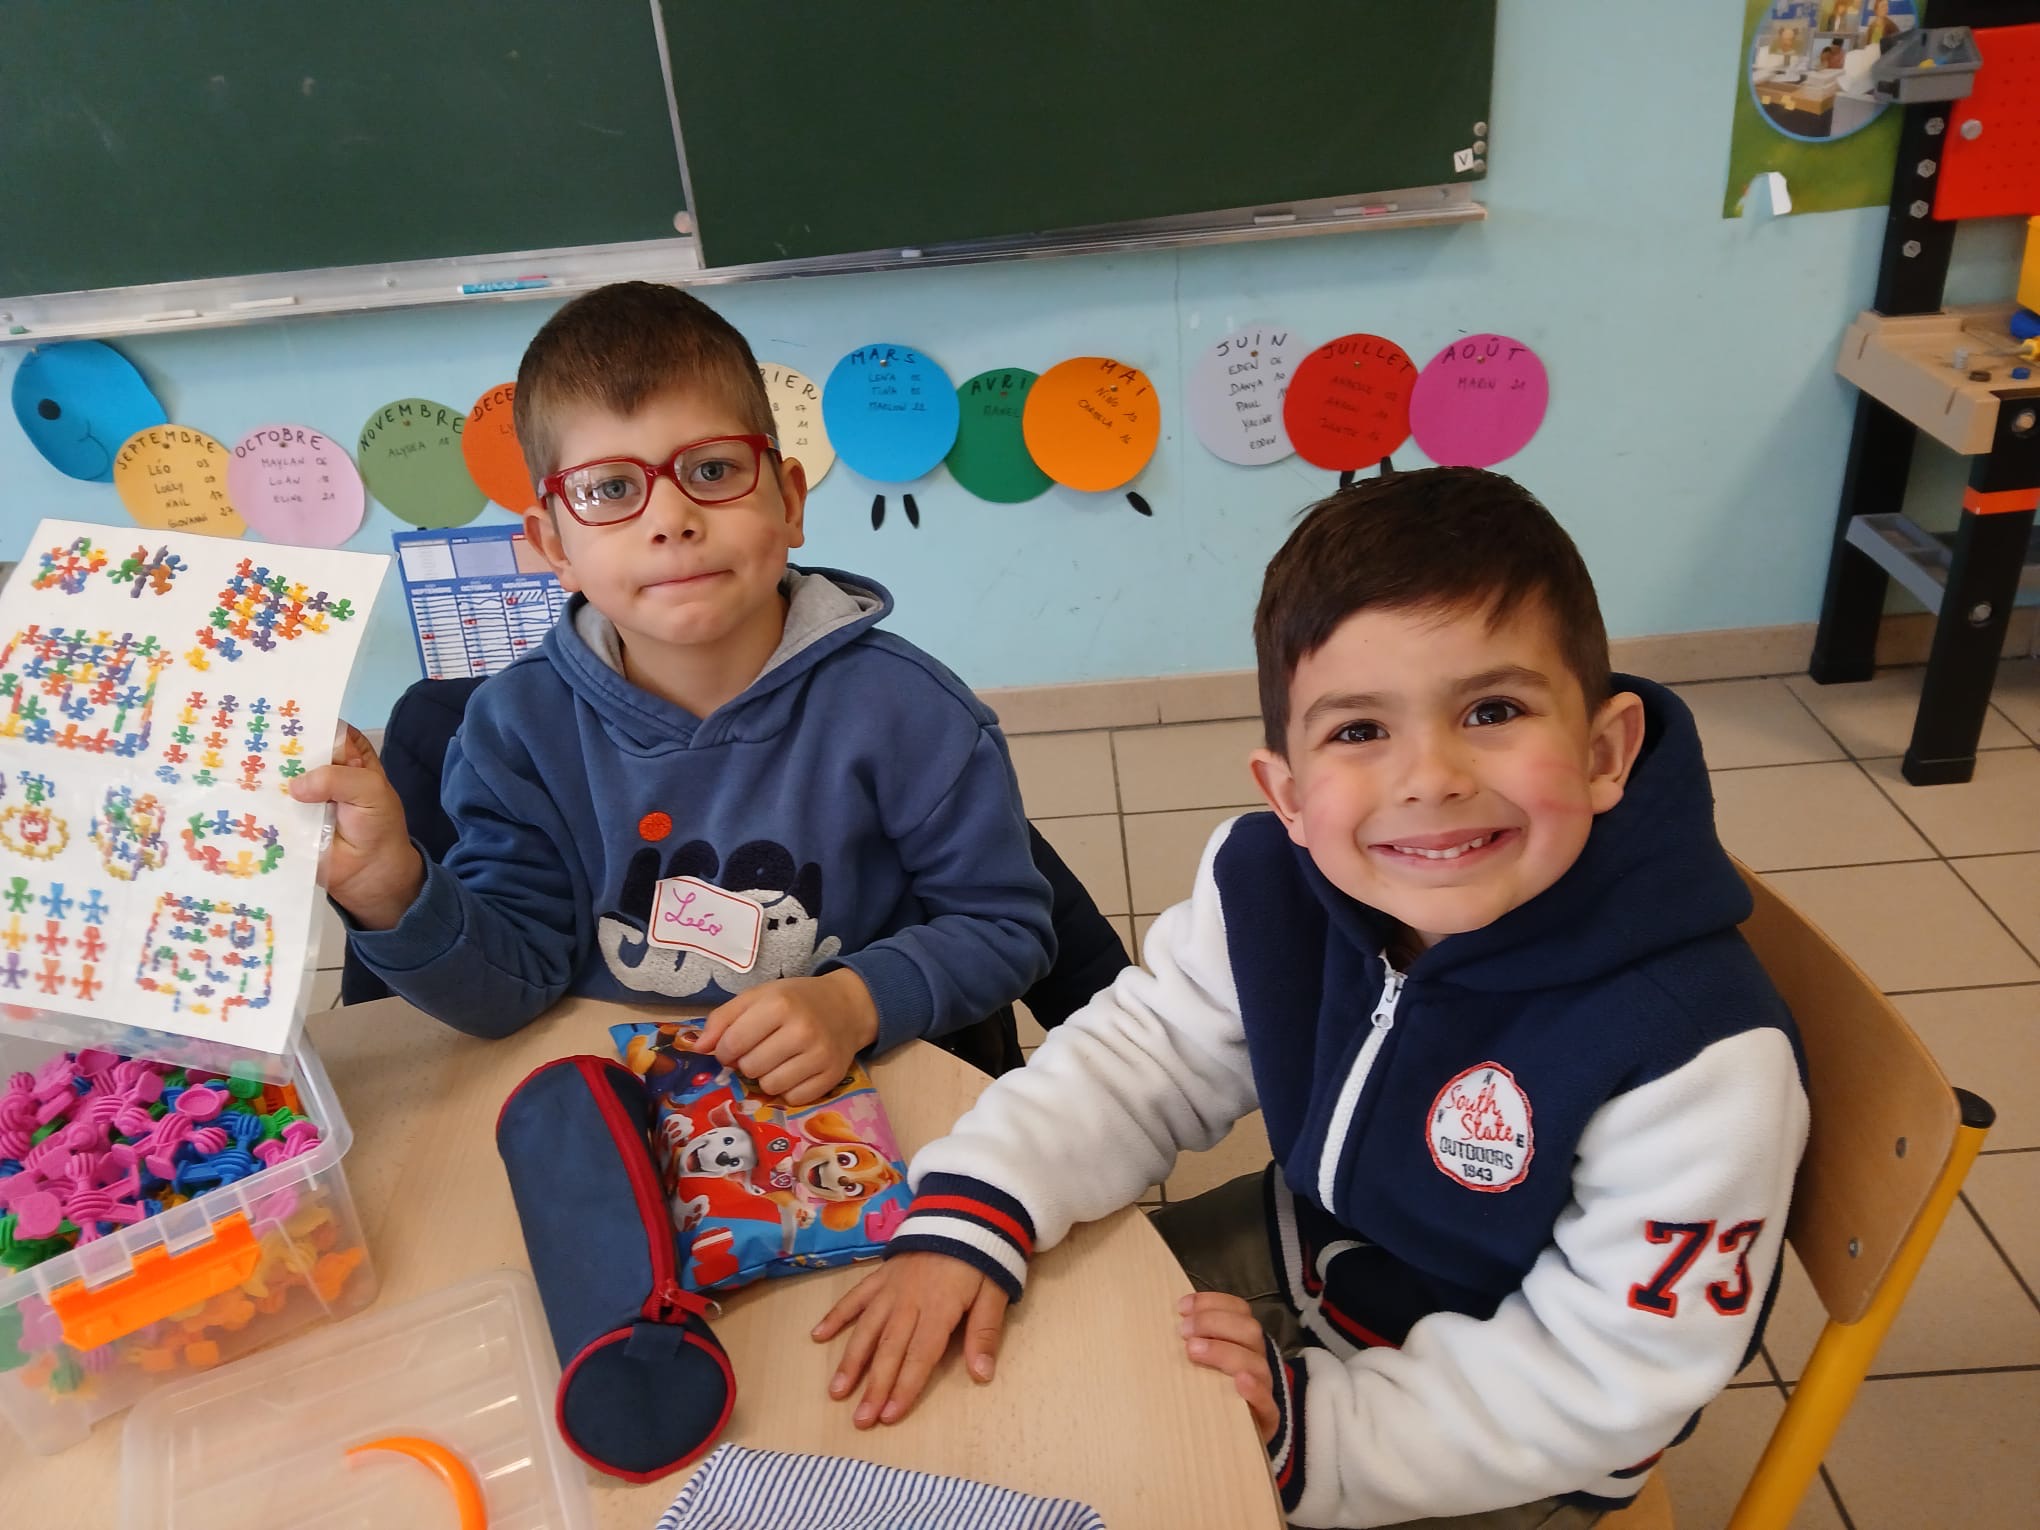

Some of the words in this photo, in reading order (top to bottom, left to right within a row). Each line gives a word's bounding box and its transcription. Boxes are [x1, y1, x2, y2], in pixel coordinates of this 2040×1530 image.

[851, 347, 915, 365] MARS
[1322, 342, 1414, 373] JUILLET
[1441, 337, 1527, 364] AOÛT
[235, 427, 324, 458] OCTOBRE
[360, 404, 466, 452] NOVEMBRE
[116, 431, 215, 470] SEPTEMBRE
[664, 887, 723, 937] Léo
[1444, 1083, 1501, 1115] South
[1460, 1110, 1514, 1142] State
[1515, 1133, 1525, 1148] E
[1439, 1136, 1514, 1170] OUTDOORS
[1627, 1217, 1767, 1319] 73
